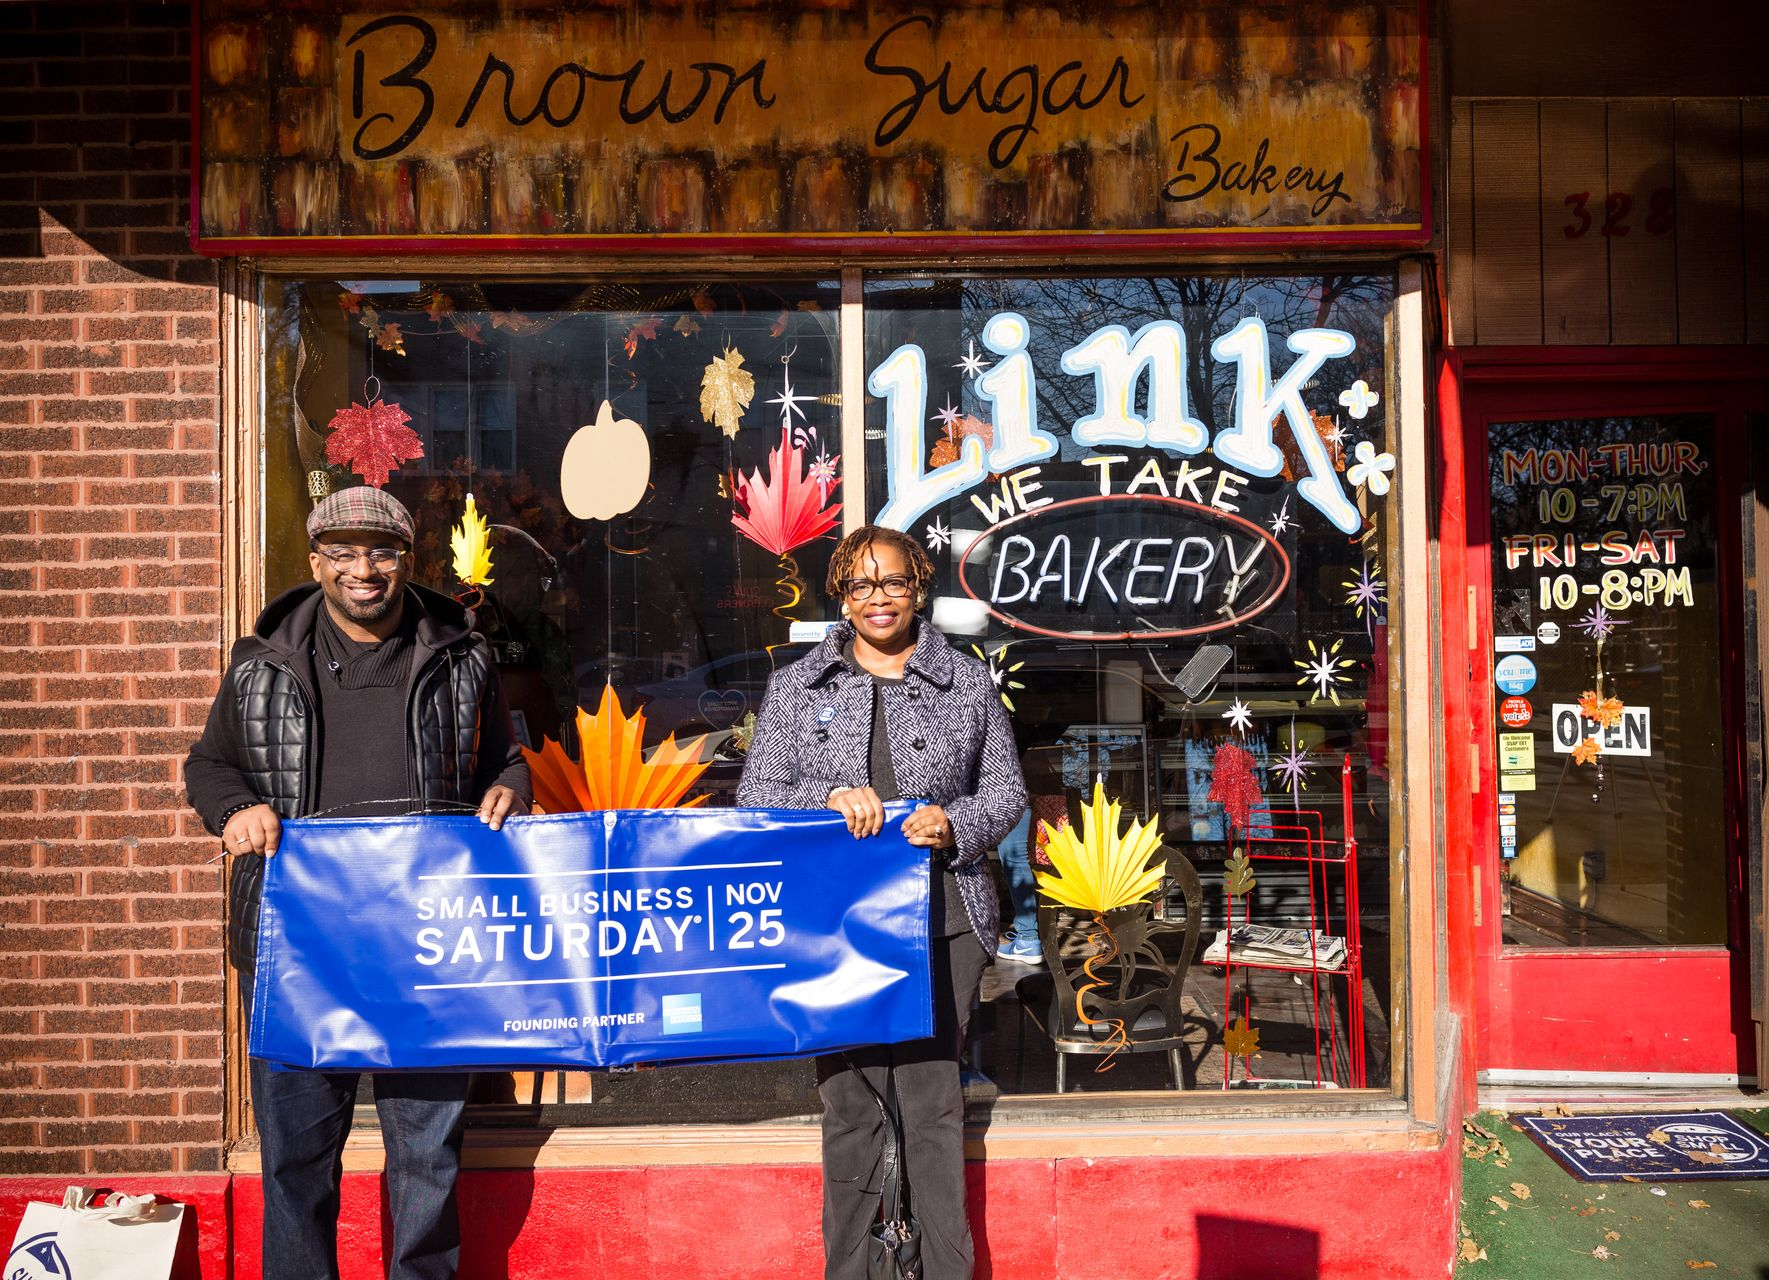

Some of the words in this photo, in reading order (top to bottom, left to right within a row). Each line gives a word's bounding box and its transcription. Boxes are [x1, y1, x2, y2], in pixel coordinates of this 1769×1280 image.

[345, 15, 776, 160] Brown
[864, 15, 1145, 169] Sugar
[1161, 123, 1352, 218] Bakery
[970, 466, 1053, 524] WE
[1081, 455, 1249, 512] TAKE
[991, 534, 1267, 606] BAKERY
[1503, 712, 1521, 721] yelp
[416, 895, 526, 921] SMALL
[538, 886, 694, 917] BUSINESS
[726, 881, 783, 906] NOV
[728, 909, 786, 949] 25
[503, 1016, 578, 1032] FOUNDING
[582, 1012, 645, 1028] PARTNER
[1560, 1137, 1652, 1148] YOUR
[1673, 1134, 1728, 1143] SHOP
[1675, 1141, 1745, 1151] SMLL
[1574, 1148, 1666, 1159] PLACE
